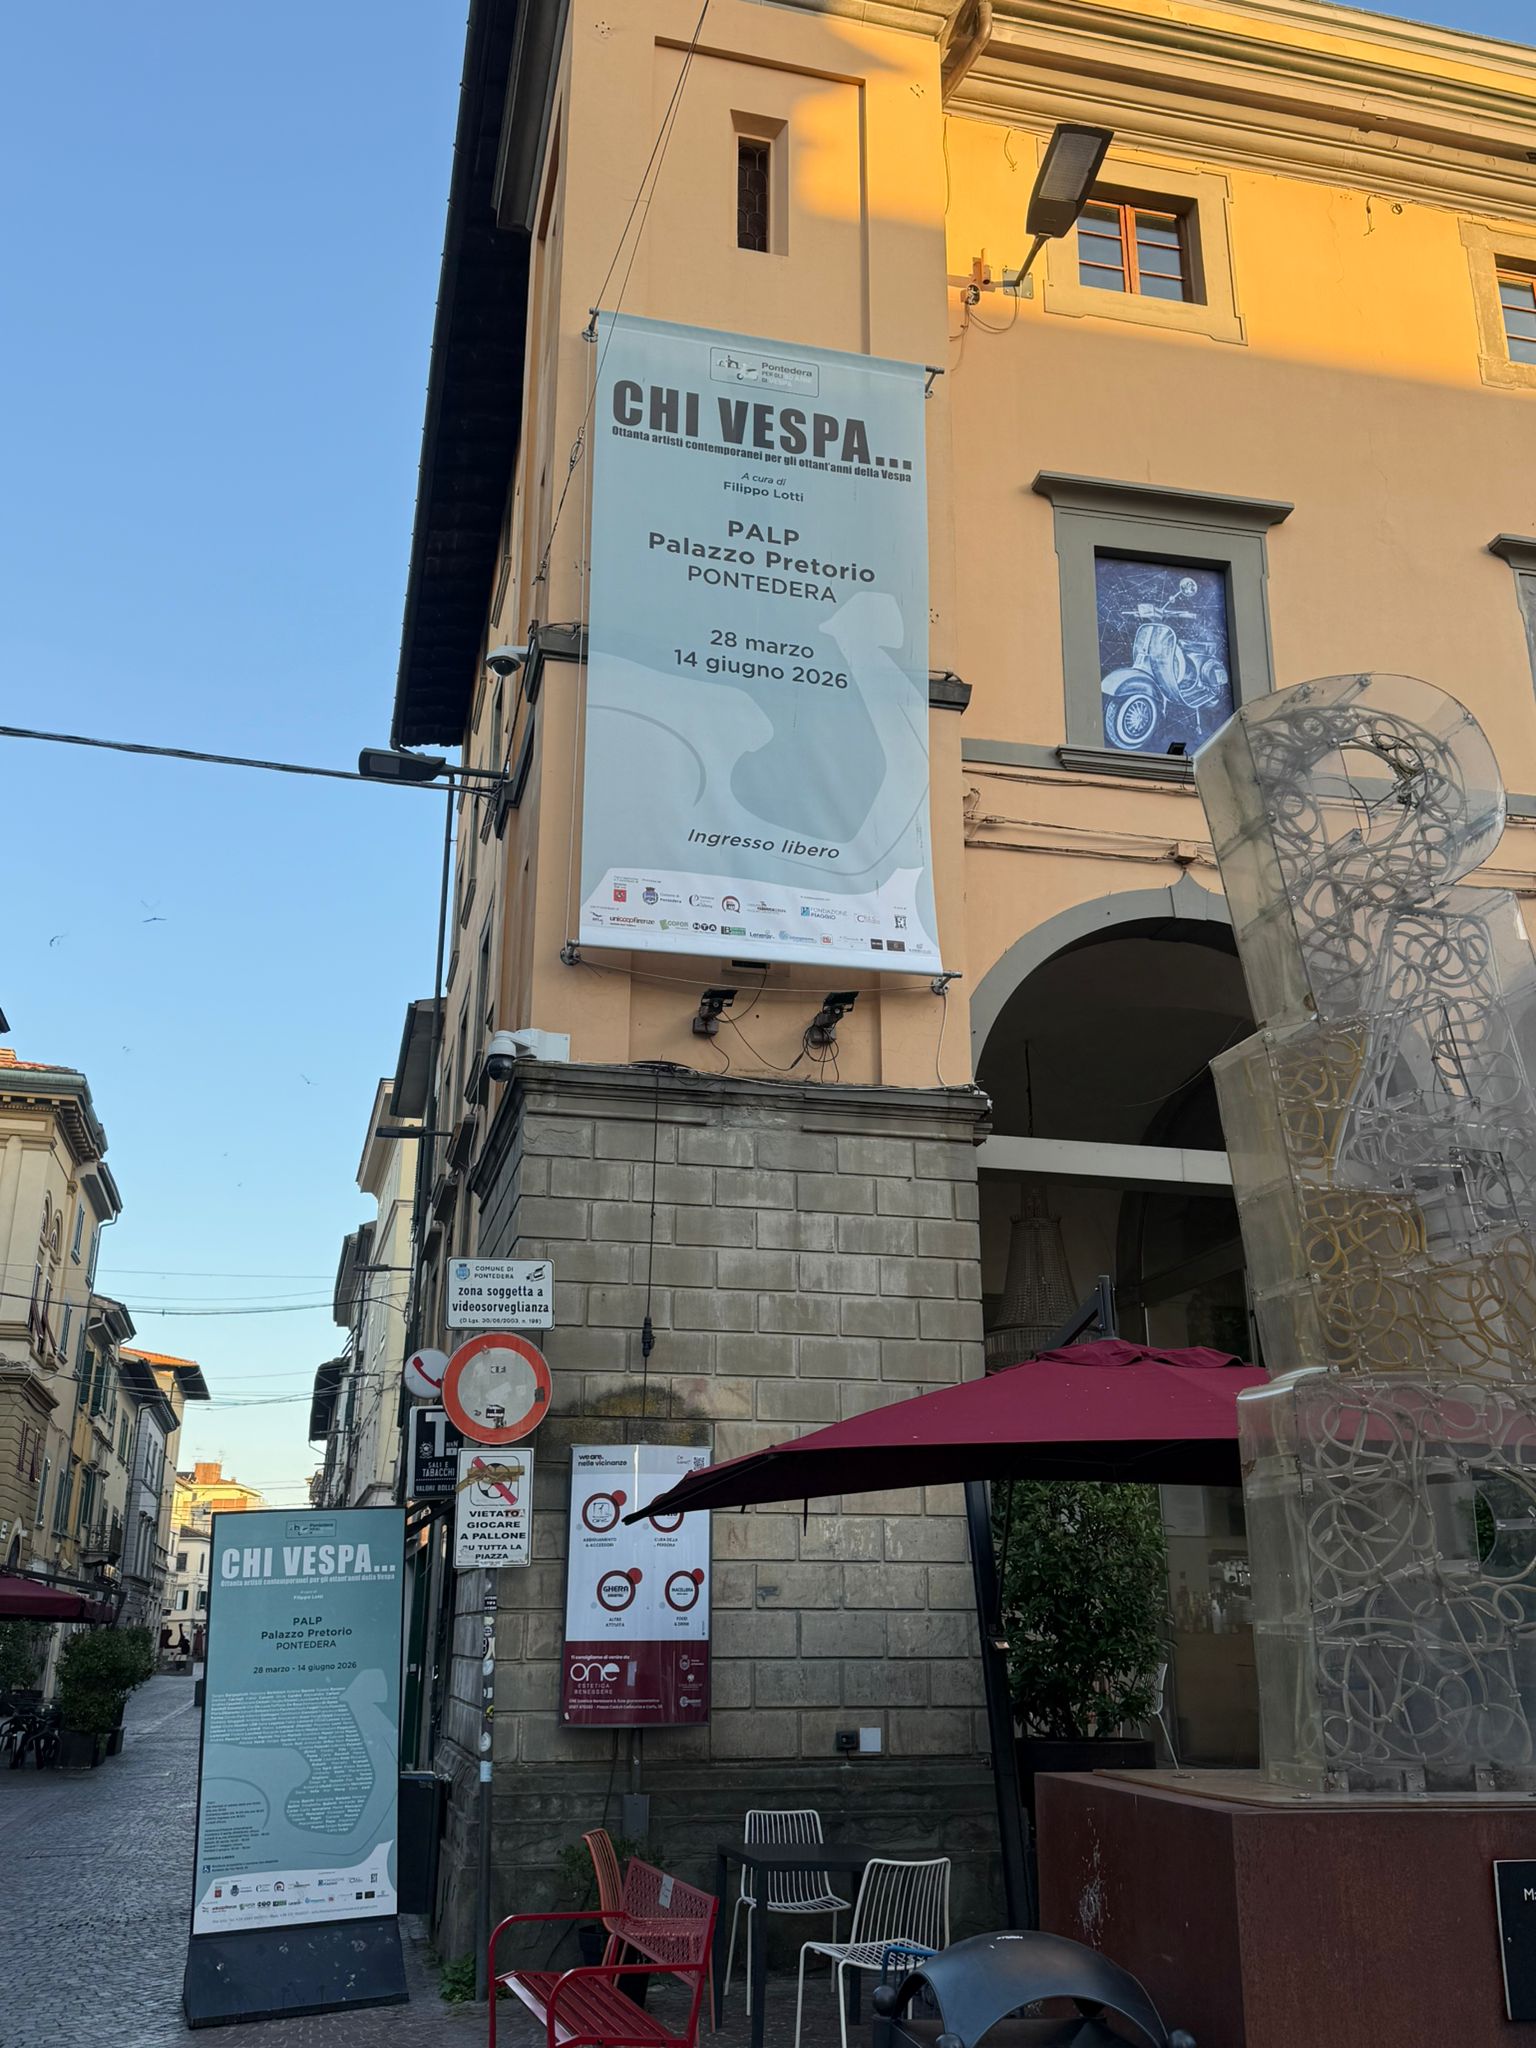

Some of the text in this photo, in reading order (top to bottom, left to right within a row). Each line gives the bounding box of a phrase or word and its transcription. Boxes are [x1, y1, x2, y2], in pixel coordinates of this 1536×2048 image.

[762, 362, 812, 377] Pontedera
[612, 380, 913, 471] CHI VESPA...
[612, 425, 912, 483] Ottanta artisti contemporanei per gli ottant'anni della Vespa
[741, 472, 787, 487] A cura di
[723, 481, 804, 503] Filippo Lotti
[728, 520, 800, 546] PALP
[649, 532, 876, 583] Palazzo Pretorio
[688, 565, 838, 603] PONTEDERA
[710, 629, 814, 659] 28 marzo
[674, 649, 848, 689] 14 giugno 2026
[687, 829, 840, 859] Ingresso libero
[458, 1286, 544, 1298] zona soggetta a
[452, 1300, 550, 1314] videosorveglianza
[425, 1412, 450, 1457] T
[422, 1468, 455, 1477] TABACCHI
[221, 1544, 396, 1580] CHI VESPA...
[293, 1617, 322, 1626] PALP
[261, 1627, 353, 1640] Palazzo Pretorio
[276, 1640, 336, 1650] PONTEDERA
[253, 1666, 263, 1674] 28
[308, 1663, 336, 1673] giugno
[337, 1662, 357, 1670] 2026
[570, 1663, 620, 1681] one
